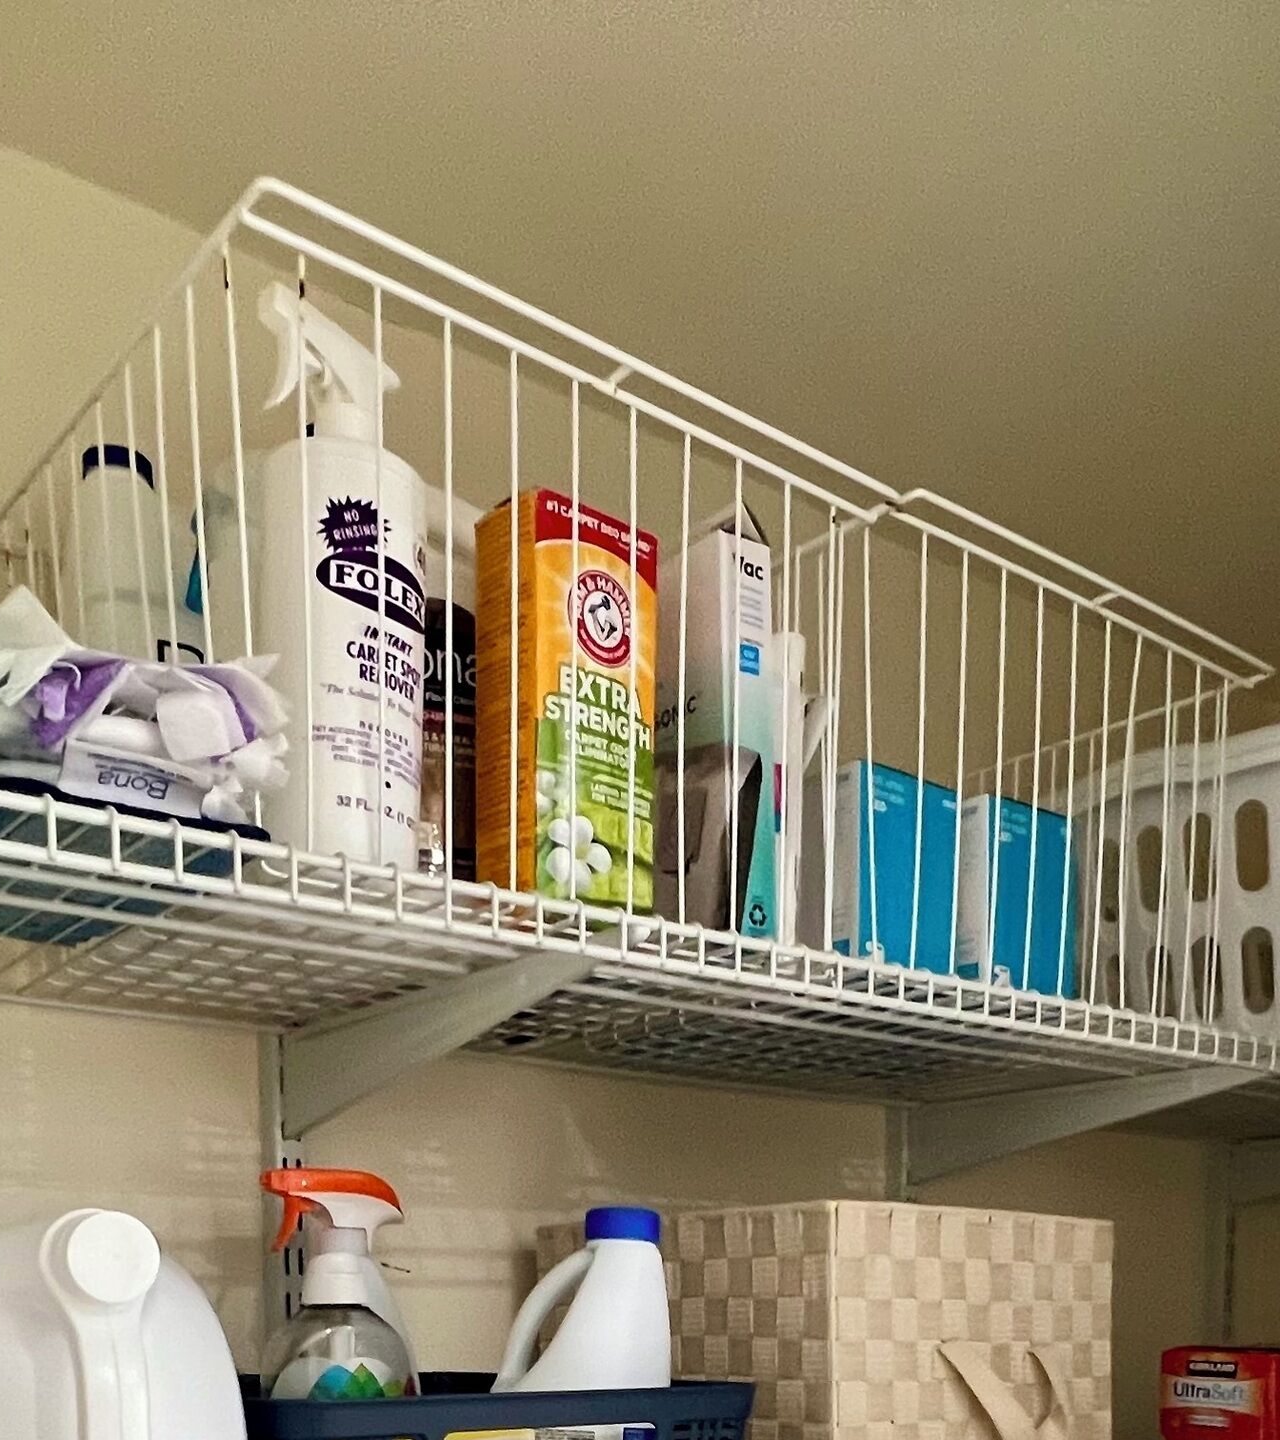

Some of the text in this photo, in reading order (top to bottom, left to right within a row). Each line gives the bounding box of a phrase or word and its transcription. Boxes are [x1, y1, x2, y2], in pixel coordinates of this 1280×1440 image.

[343, 508, 360, 523] NO
[332, 523, 379, 542] RINSING
[364, 625, 413, 657] INTANT
[560, 665, 642, 719] EXTRA
[545, 694, 651, 750] STRENGTH
[97, 770, 170, 800] Bona
